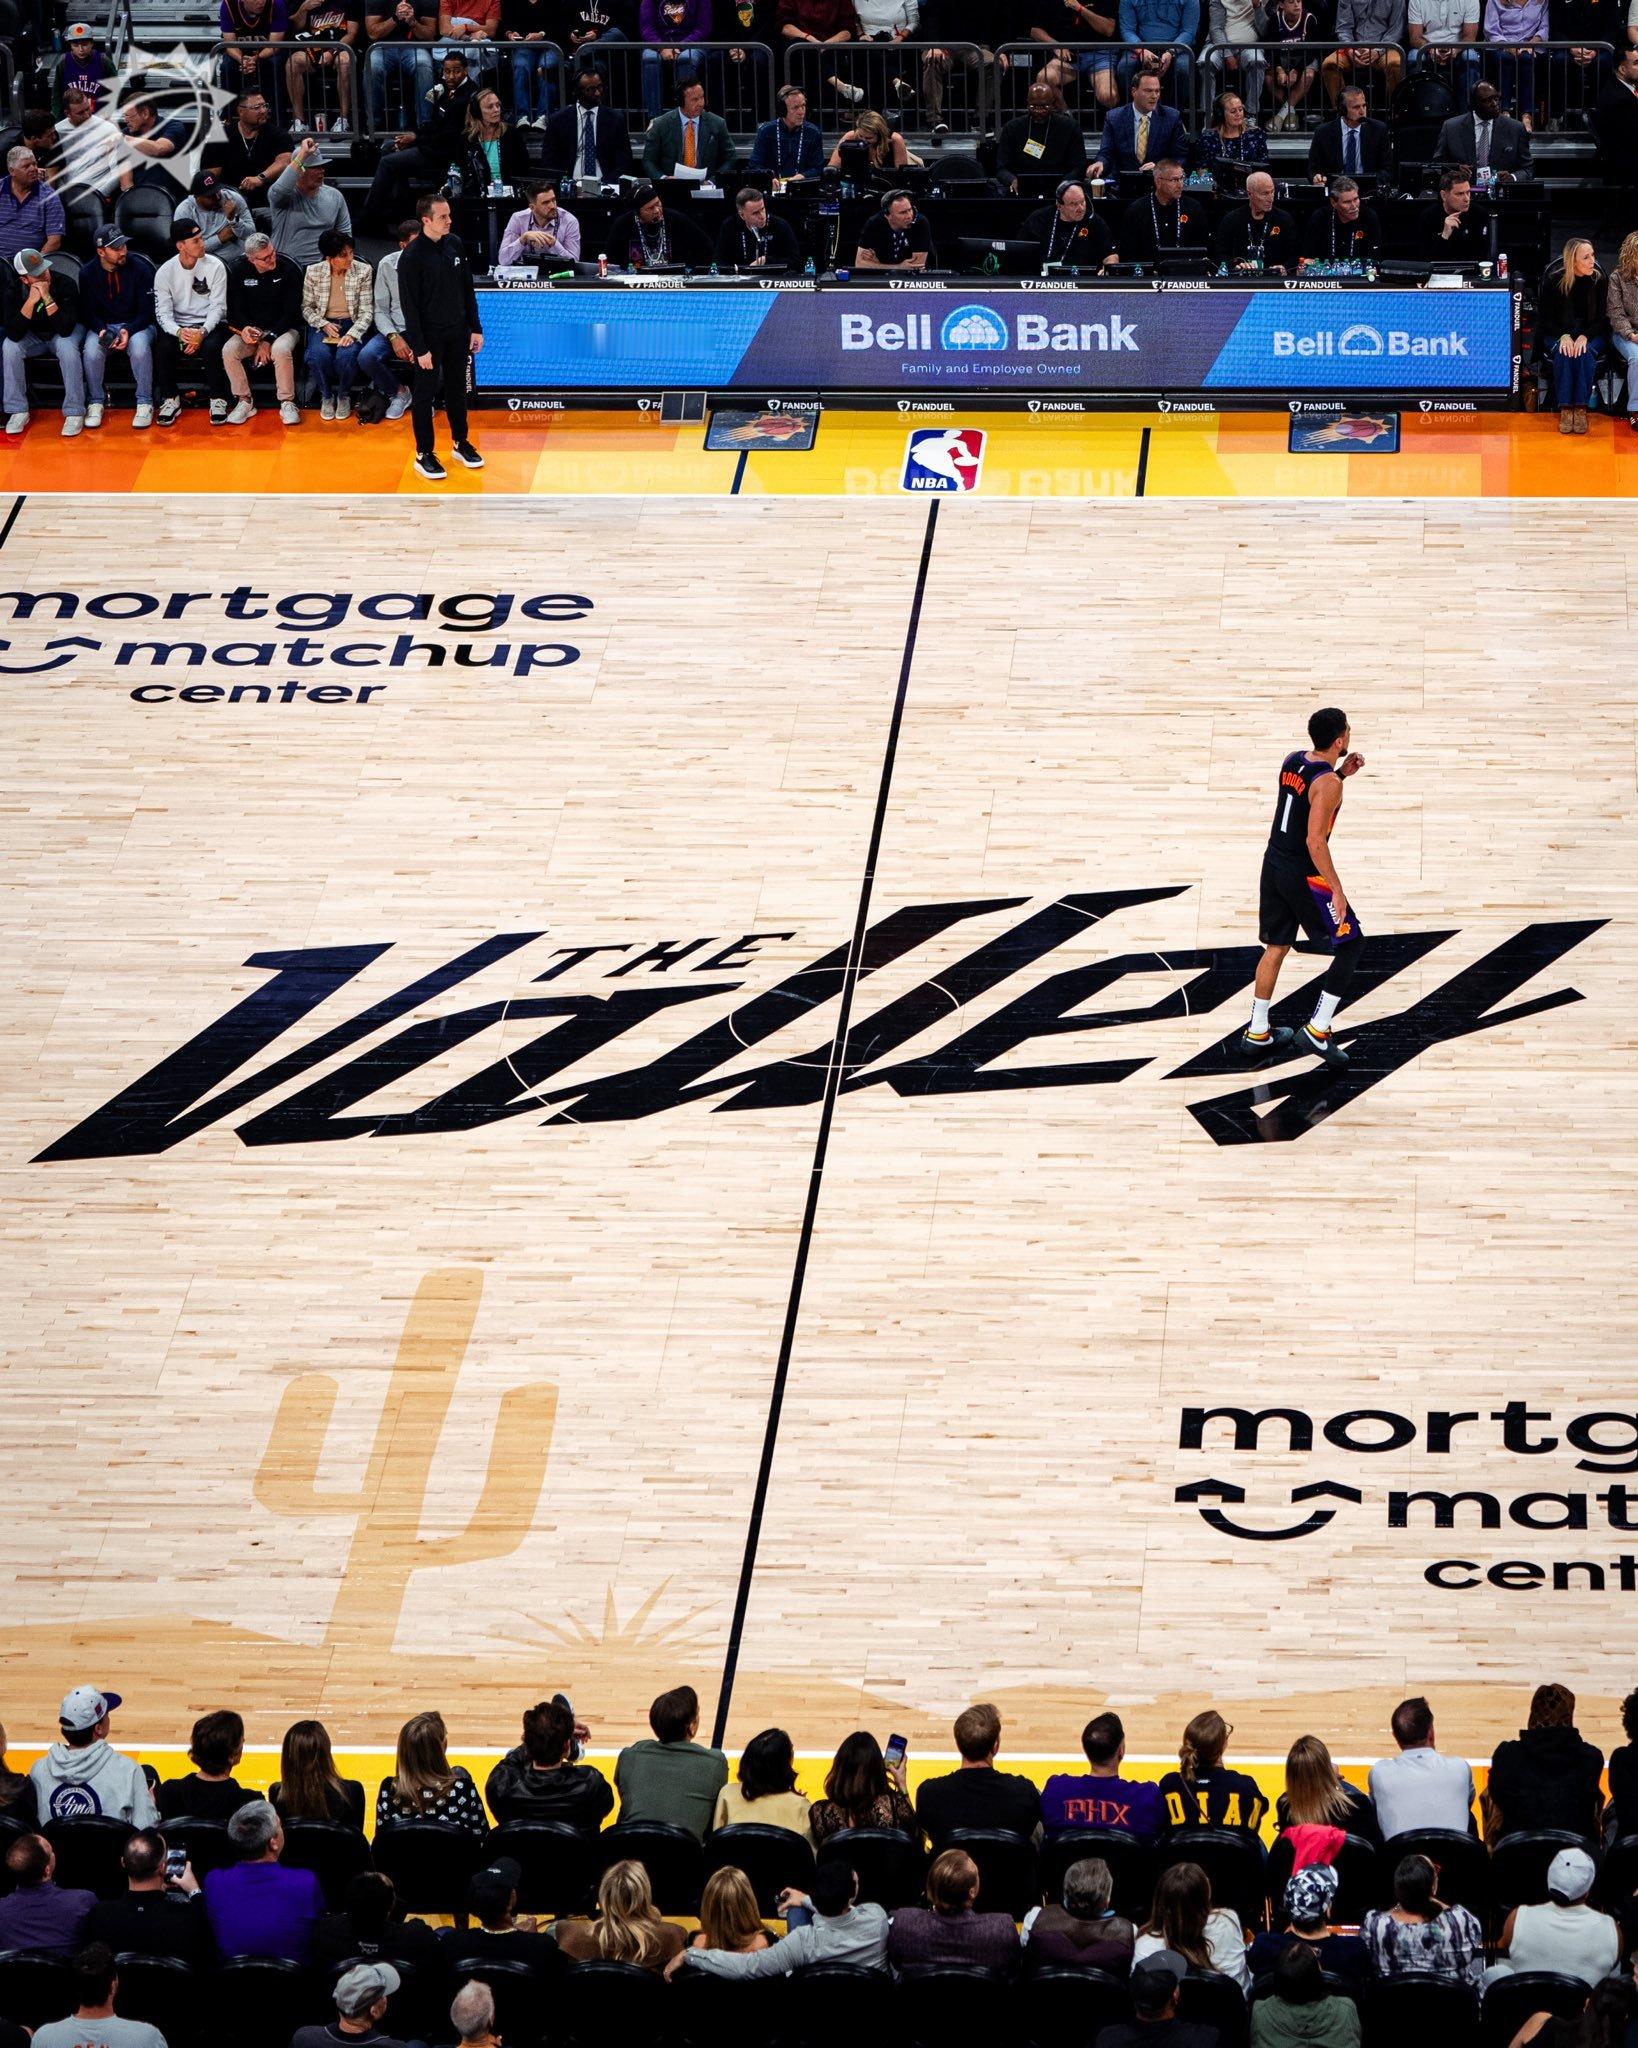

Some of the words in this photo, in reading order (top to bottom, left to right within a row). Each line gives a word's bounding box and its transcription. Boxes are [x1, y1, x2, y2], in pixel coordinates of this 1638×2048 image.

[512, 281, 555, 289] FANDUEL
[774, 280, 818, 288] FANDUEL
[903, 281, 947, 290] FANDUEL
[1035, 281, 1078, 290] FANDUEL
[1167, 281, 1211, 289] FANDUEL
[1299, 281, 1343, 289] FANDUEL
[841, 314, 931, 351] Bell
[1017, 314, 1140, 351] Bank
[1274, 331, 1334, 356] Bell
[1388, 331, 1469, 356] Bank
[901, 363, 942, 376] Family
[945, 363, 969, 374] and
[972, 363, 1033, 376] Employee
[1037, 363, 1081, 374] Owned
[1512, 364, 1520, 394] FANDUEL
[522, 401, 565, 409] FANDUEL
[782, 402, 825, 410] FANDUEL
[912, 402, 955, 411] FANDUEL
[1043, 402, 1085, 411] FANDUEL
[1173, 403, 1216, 411] FANDUEL
[1303, 402, 1346, 411] FANDUEL
[1434, 402, 1477, 411] FANDUEL
[911, 477, 948, 489] NBA
[0, 586, 594, 632] mortgage
[114, 635, 581, 676] matchup
[130, 681, 387, 704] center
[1281, 771, 1306, 797] BOOKER
[1280, 793, 1294, 834] 1
[533, 931, 796, 979] THE
[30, 885, 1610, 1163] Valley
[1179, 1401, 1638, 1474] mortg
[1388, 1484, 1638, 1531] mat
[1424, 1555, 1638, 1591] cent
[1064, 1799, 1132, 1826] PHX
